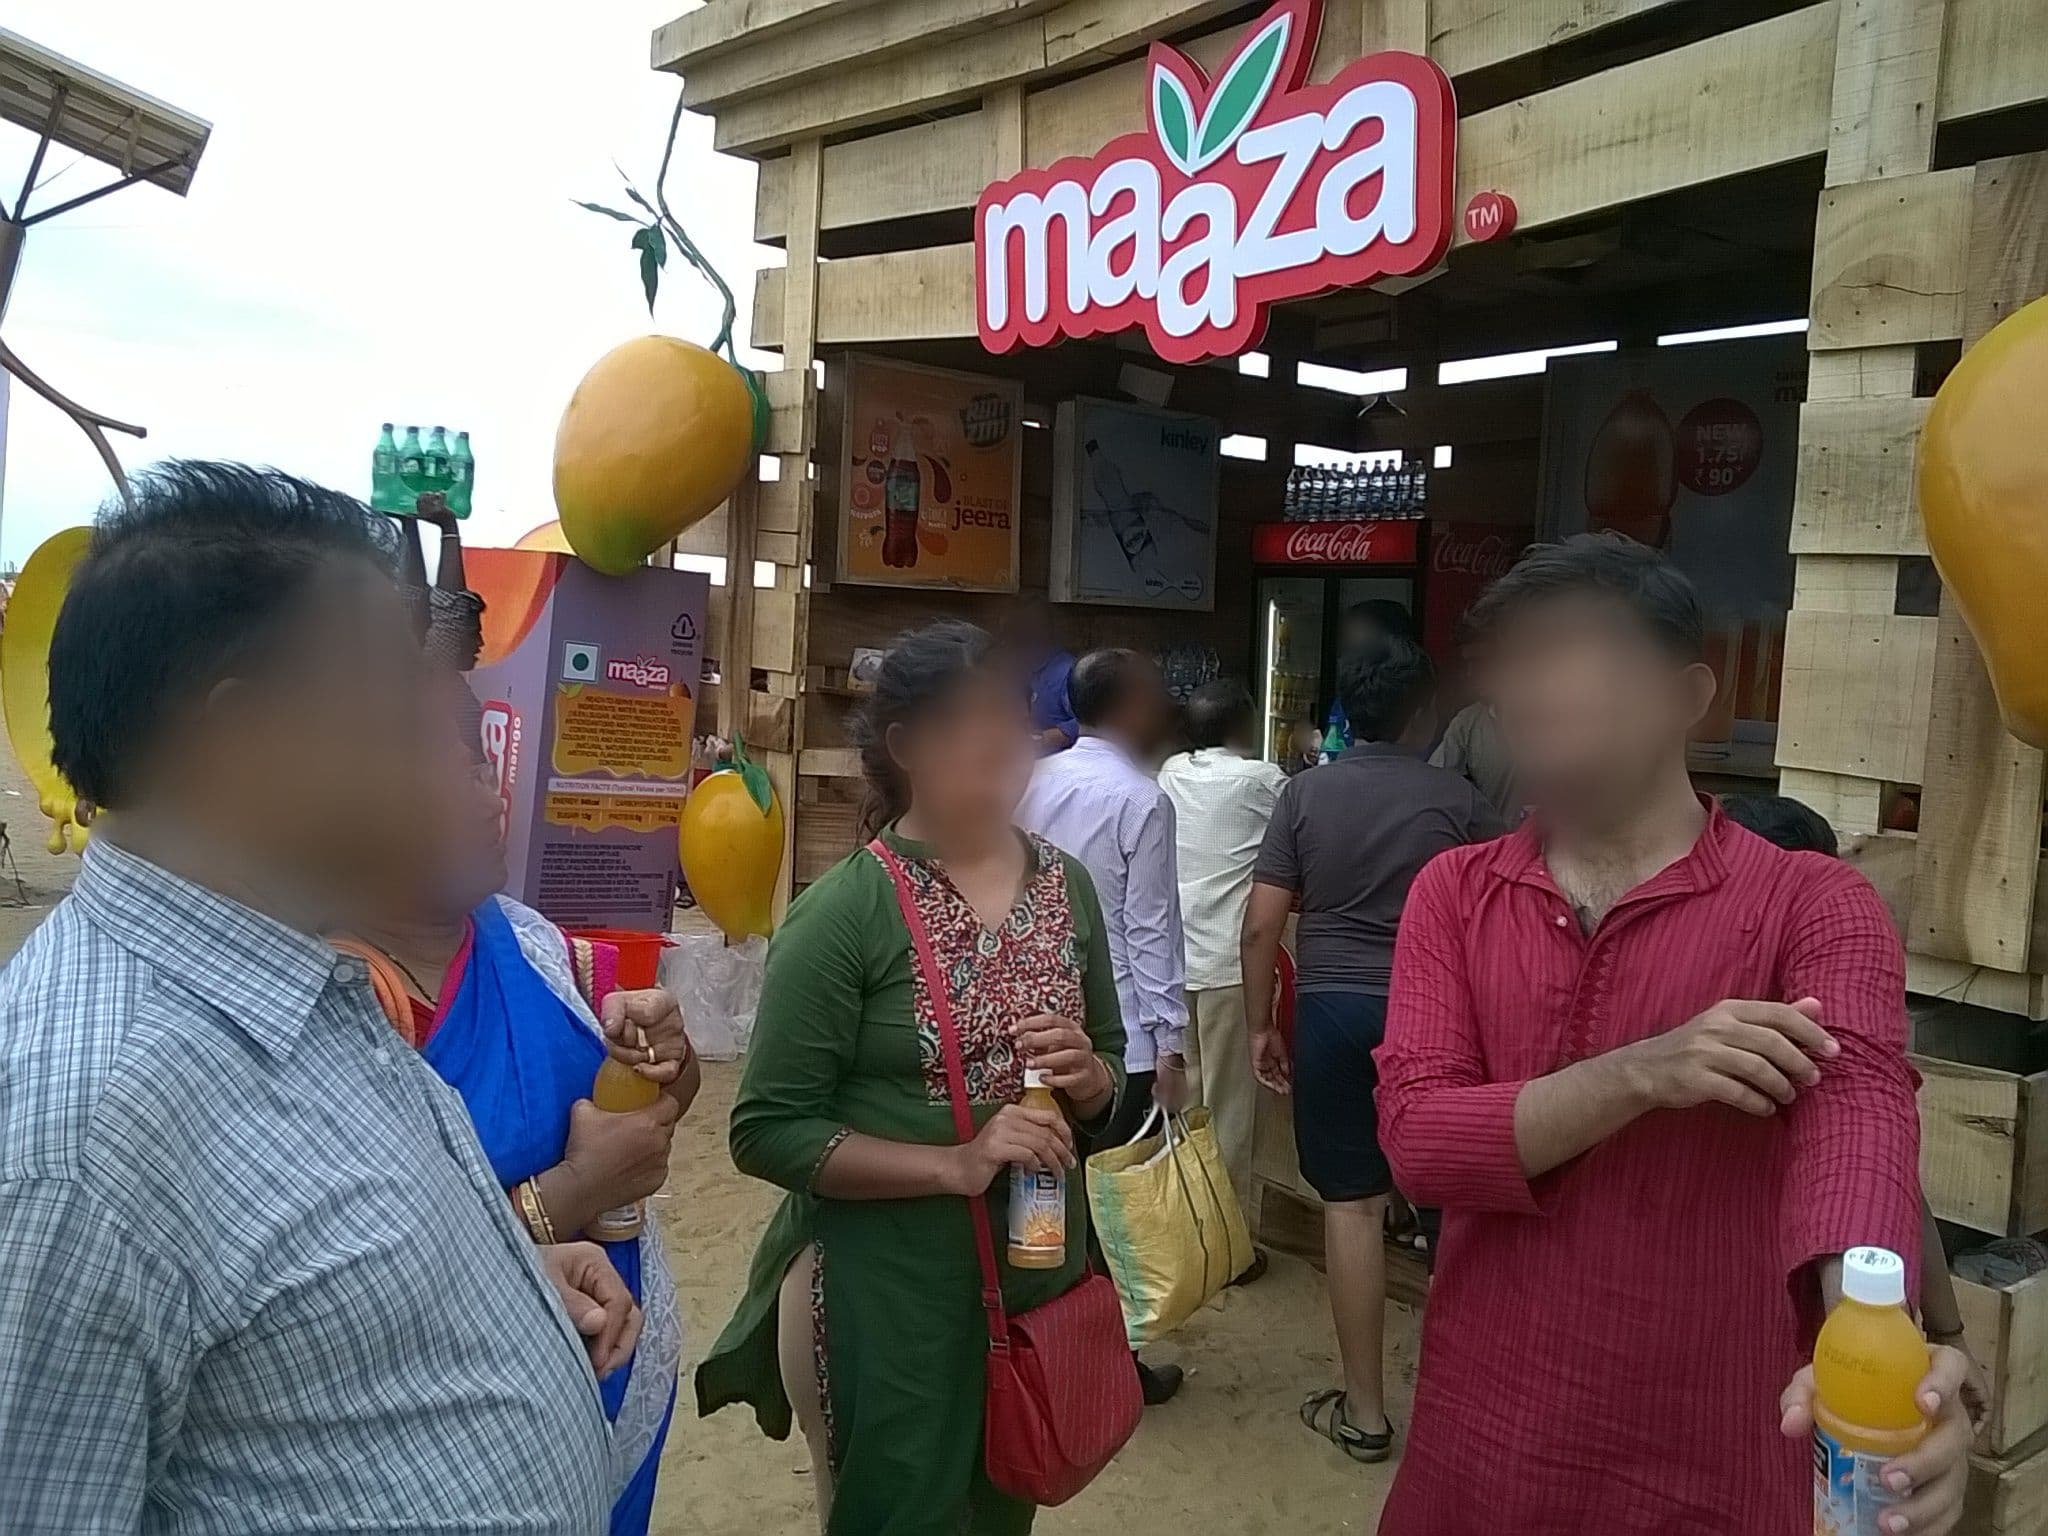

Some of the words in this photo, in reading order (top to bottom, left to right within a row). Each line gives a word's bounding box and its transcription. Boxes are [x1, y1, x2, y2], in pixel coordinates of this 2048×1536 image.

[985, 81, 1418, 338] maaza
[1468, 205, 1500, 229] TM
[1160, 424, 1209, 455] kinley
[1696, 424, 1747, 444] NEW
[952, 500, 1011, 531] jeera
[608, 660, 669, 686] maaza
